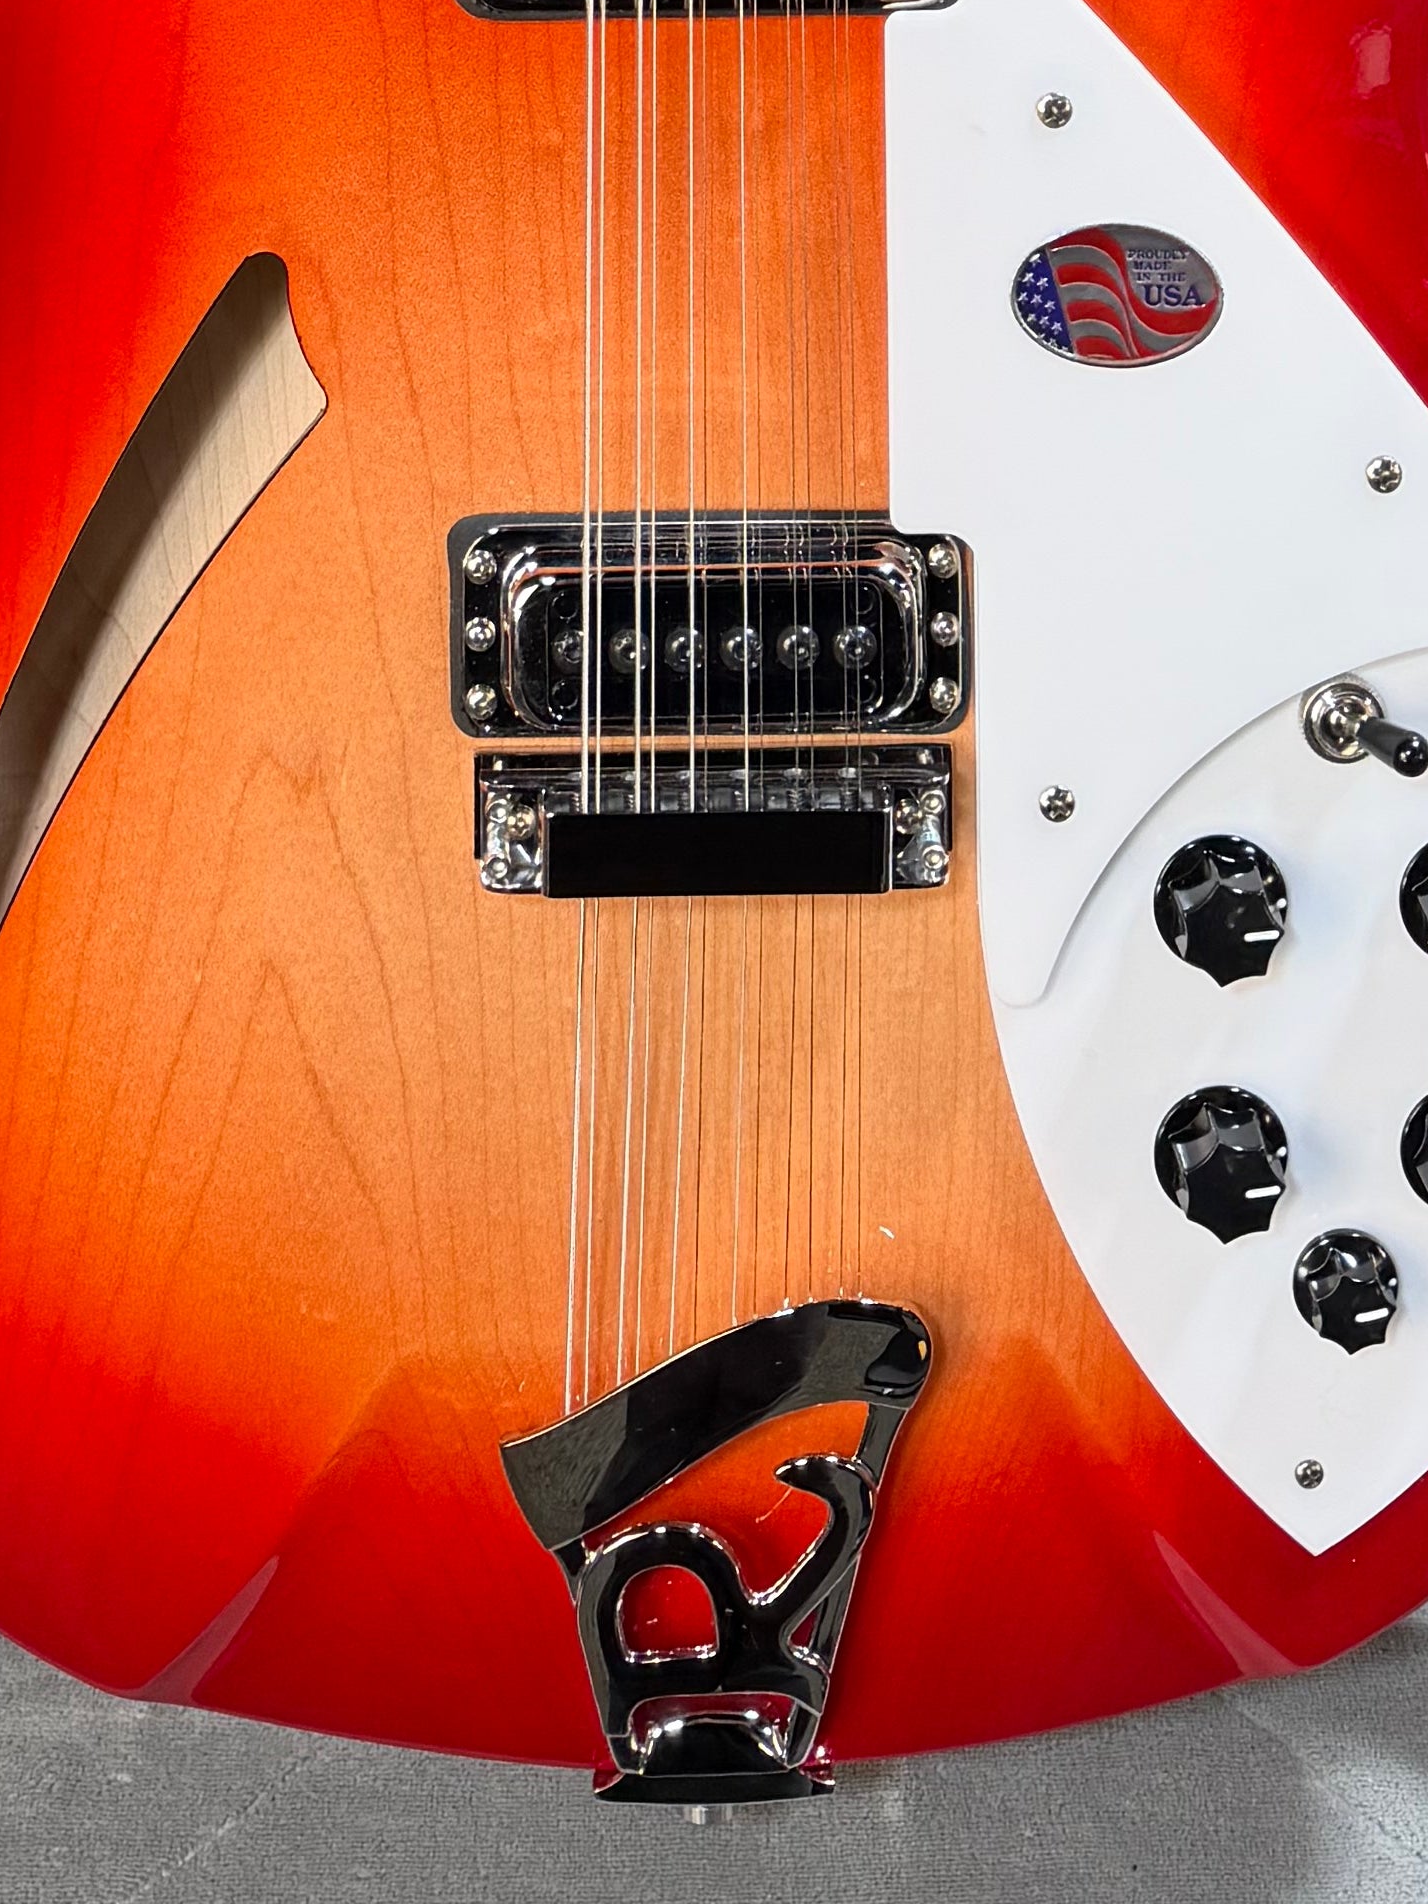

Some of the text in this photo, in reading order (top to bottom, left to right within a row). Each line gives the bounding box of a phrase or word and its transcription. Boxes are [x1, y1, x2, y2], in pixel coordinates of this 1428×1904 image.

[1126, 247, 1189, 261] PROUDLY
[1133, 260, 1171, 271] MADE
[1136, 272, 1186, 283] IN THE
[1142, 283, 1206, 308] USA
